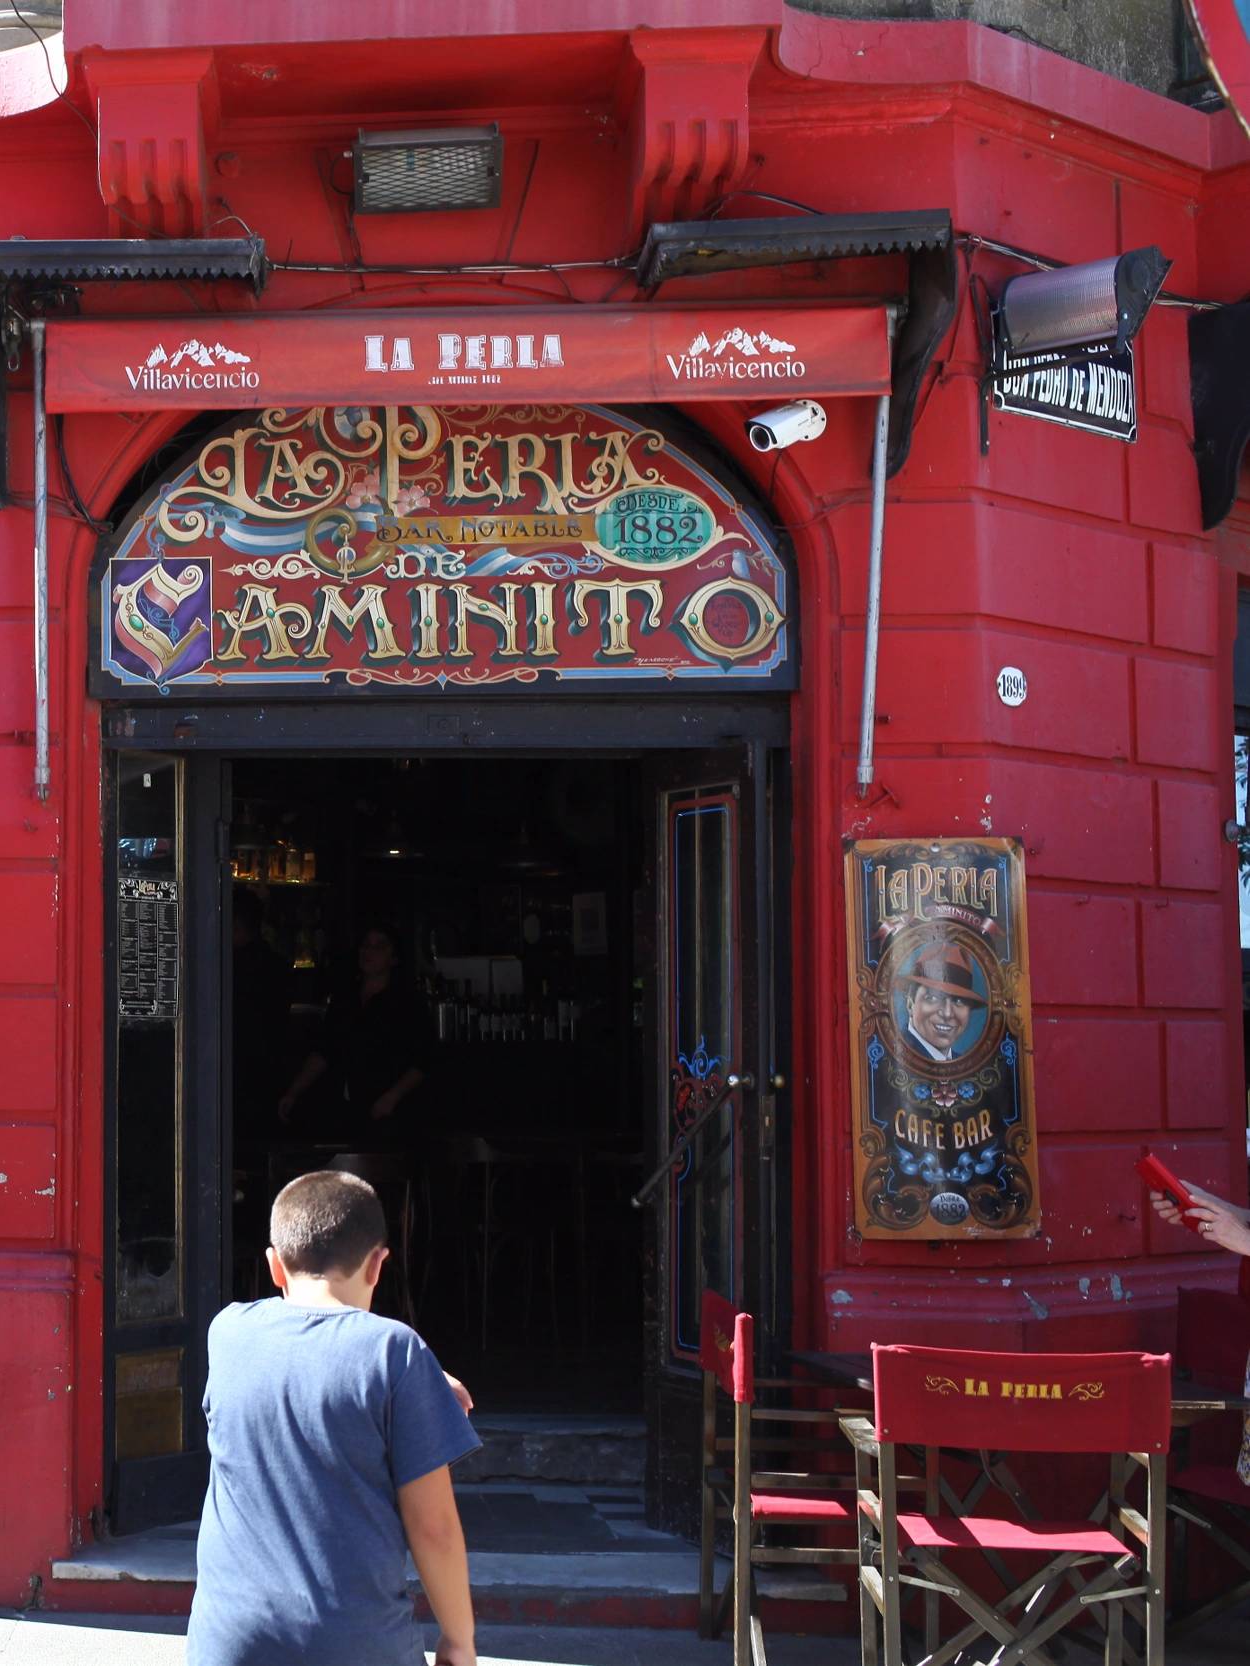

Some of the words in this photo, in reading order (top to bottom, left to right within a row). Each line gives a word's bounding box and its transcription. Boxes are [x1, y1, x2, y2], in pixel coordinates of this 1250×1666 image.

[364, 335, 415, 373] LA
[437, 333, 565, 371] PERLA
[666, 354, 806, 380] Villavicencio
[125, 365, 260, 391] Villavicencio
[1031, 365, 1069, 408] PEDRO
[1069, 367, 1086, 412] DE
[1086, 361, 1135, 424] MENDOZA
[158, 428, 345, 543] LA
[318, 407, 665, 522] PERLA
[616, 492, 680, 514] DESDE
[375, 515, 453, 544] BAR
[460, 516, 583, 543] NOTABLE
[613, 514, 704, 545] 1882
[115, 563, 786, 686] CAMINITO
[876, 864, 910, 924] LA
[911, 862, 999, 922] PERLA
[953, 1108, 994, 1150] BAR
[964, 1378, 990, 1397] LA
[1000, 1381, 1064, 1400] PERLA
